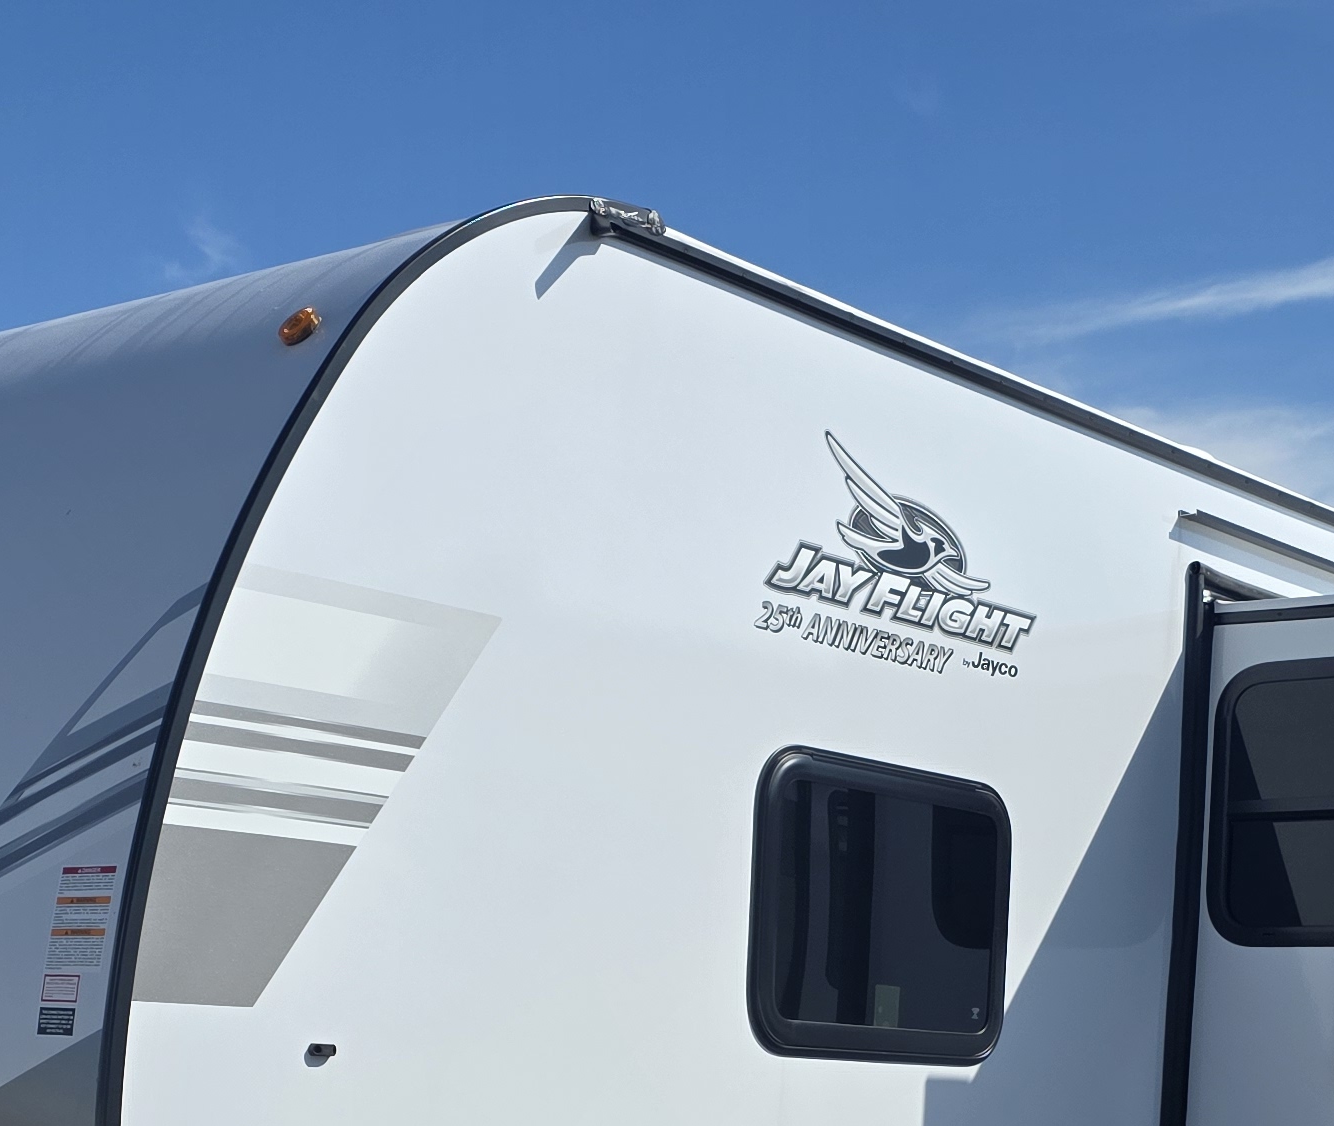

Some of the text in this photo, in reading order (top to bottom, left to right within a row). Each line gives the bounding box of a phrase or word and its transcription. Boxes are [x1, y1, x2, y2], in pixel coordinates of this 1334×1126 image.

[754, 600, 1018, 678] 25th ANNIVERSARY by Jayco
[764, 540, 1037, 654] JAY FLIGHT
